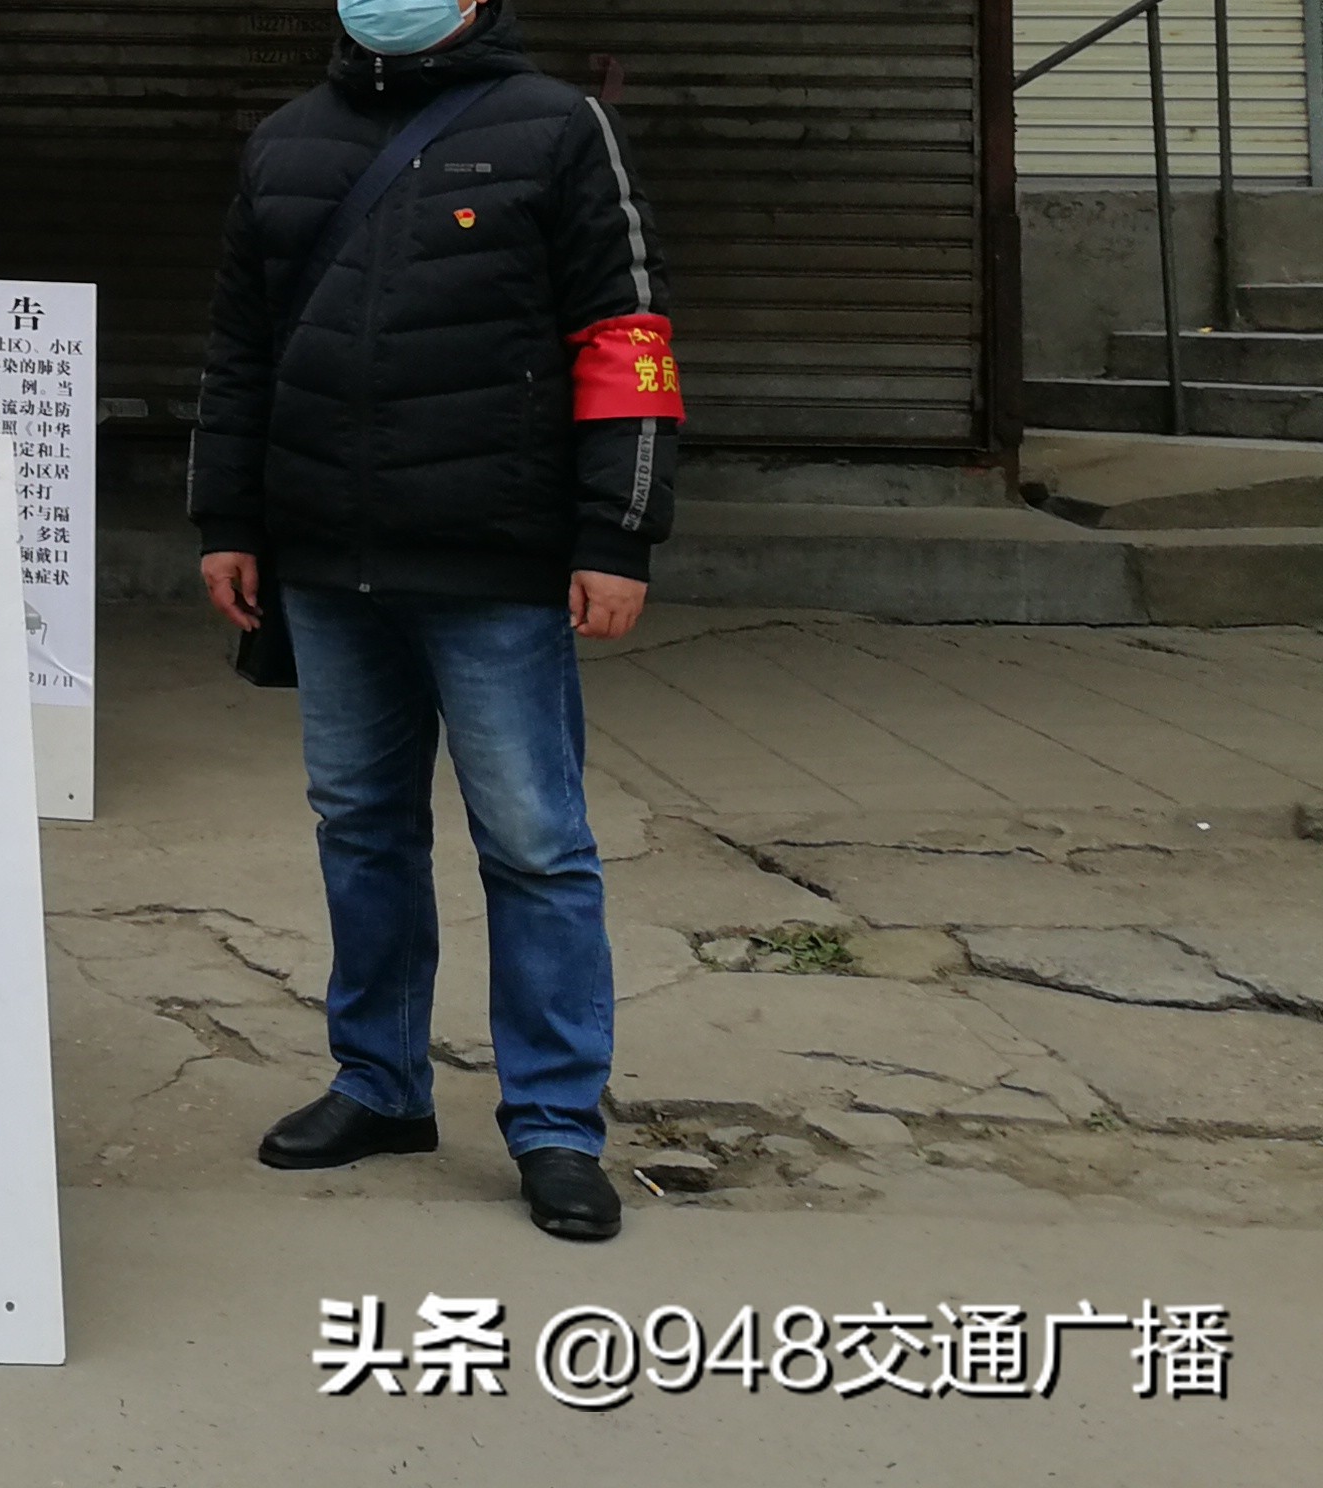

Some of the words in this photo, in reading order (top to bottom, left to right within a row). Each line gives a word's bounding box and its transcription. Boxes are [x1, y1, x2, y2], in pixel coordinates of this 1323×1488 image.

[19, 462, 70, 480] 小区居
[19, 505, 70, 523] 不与隔
